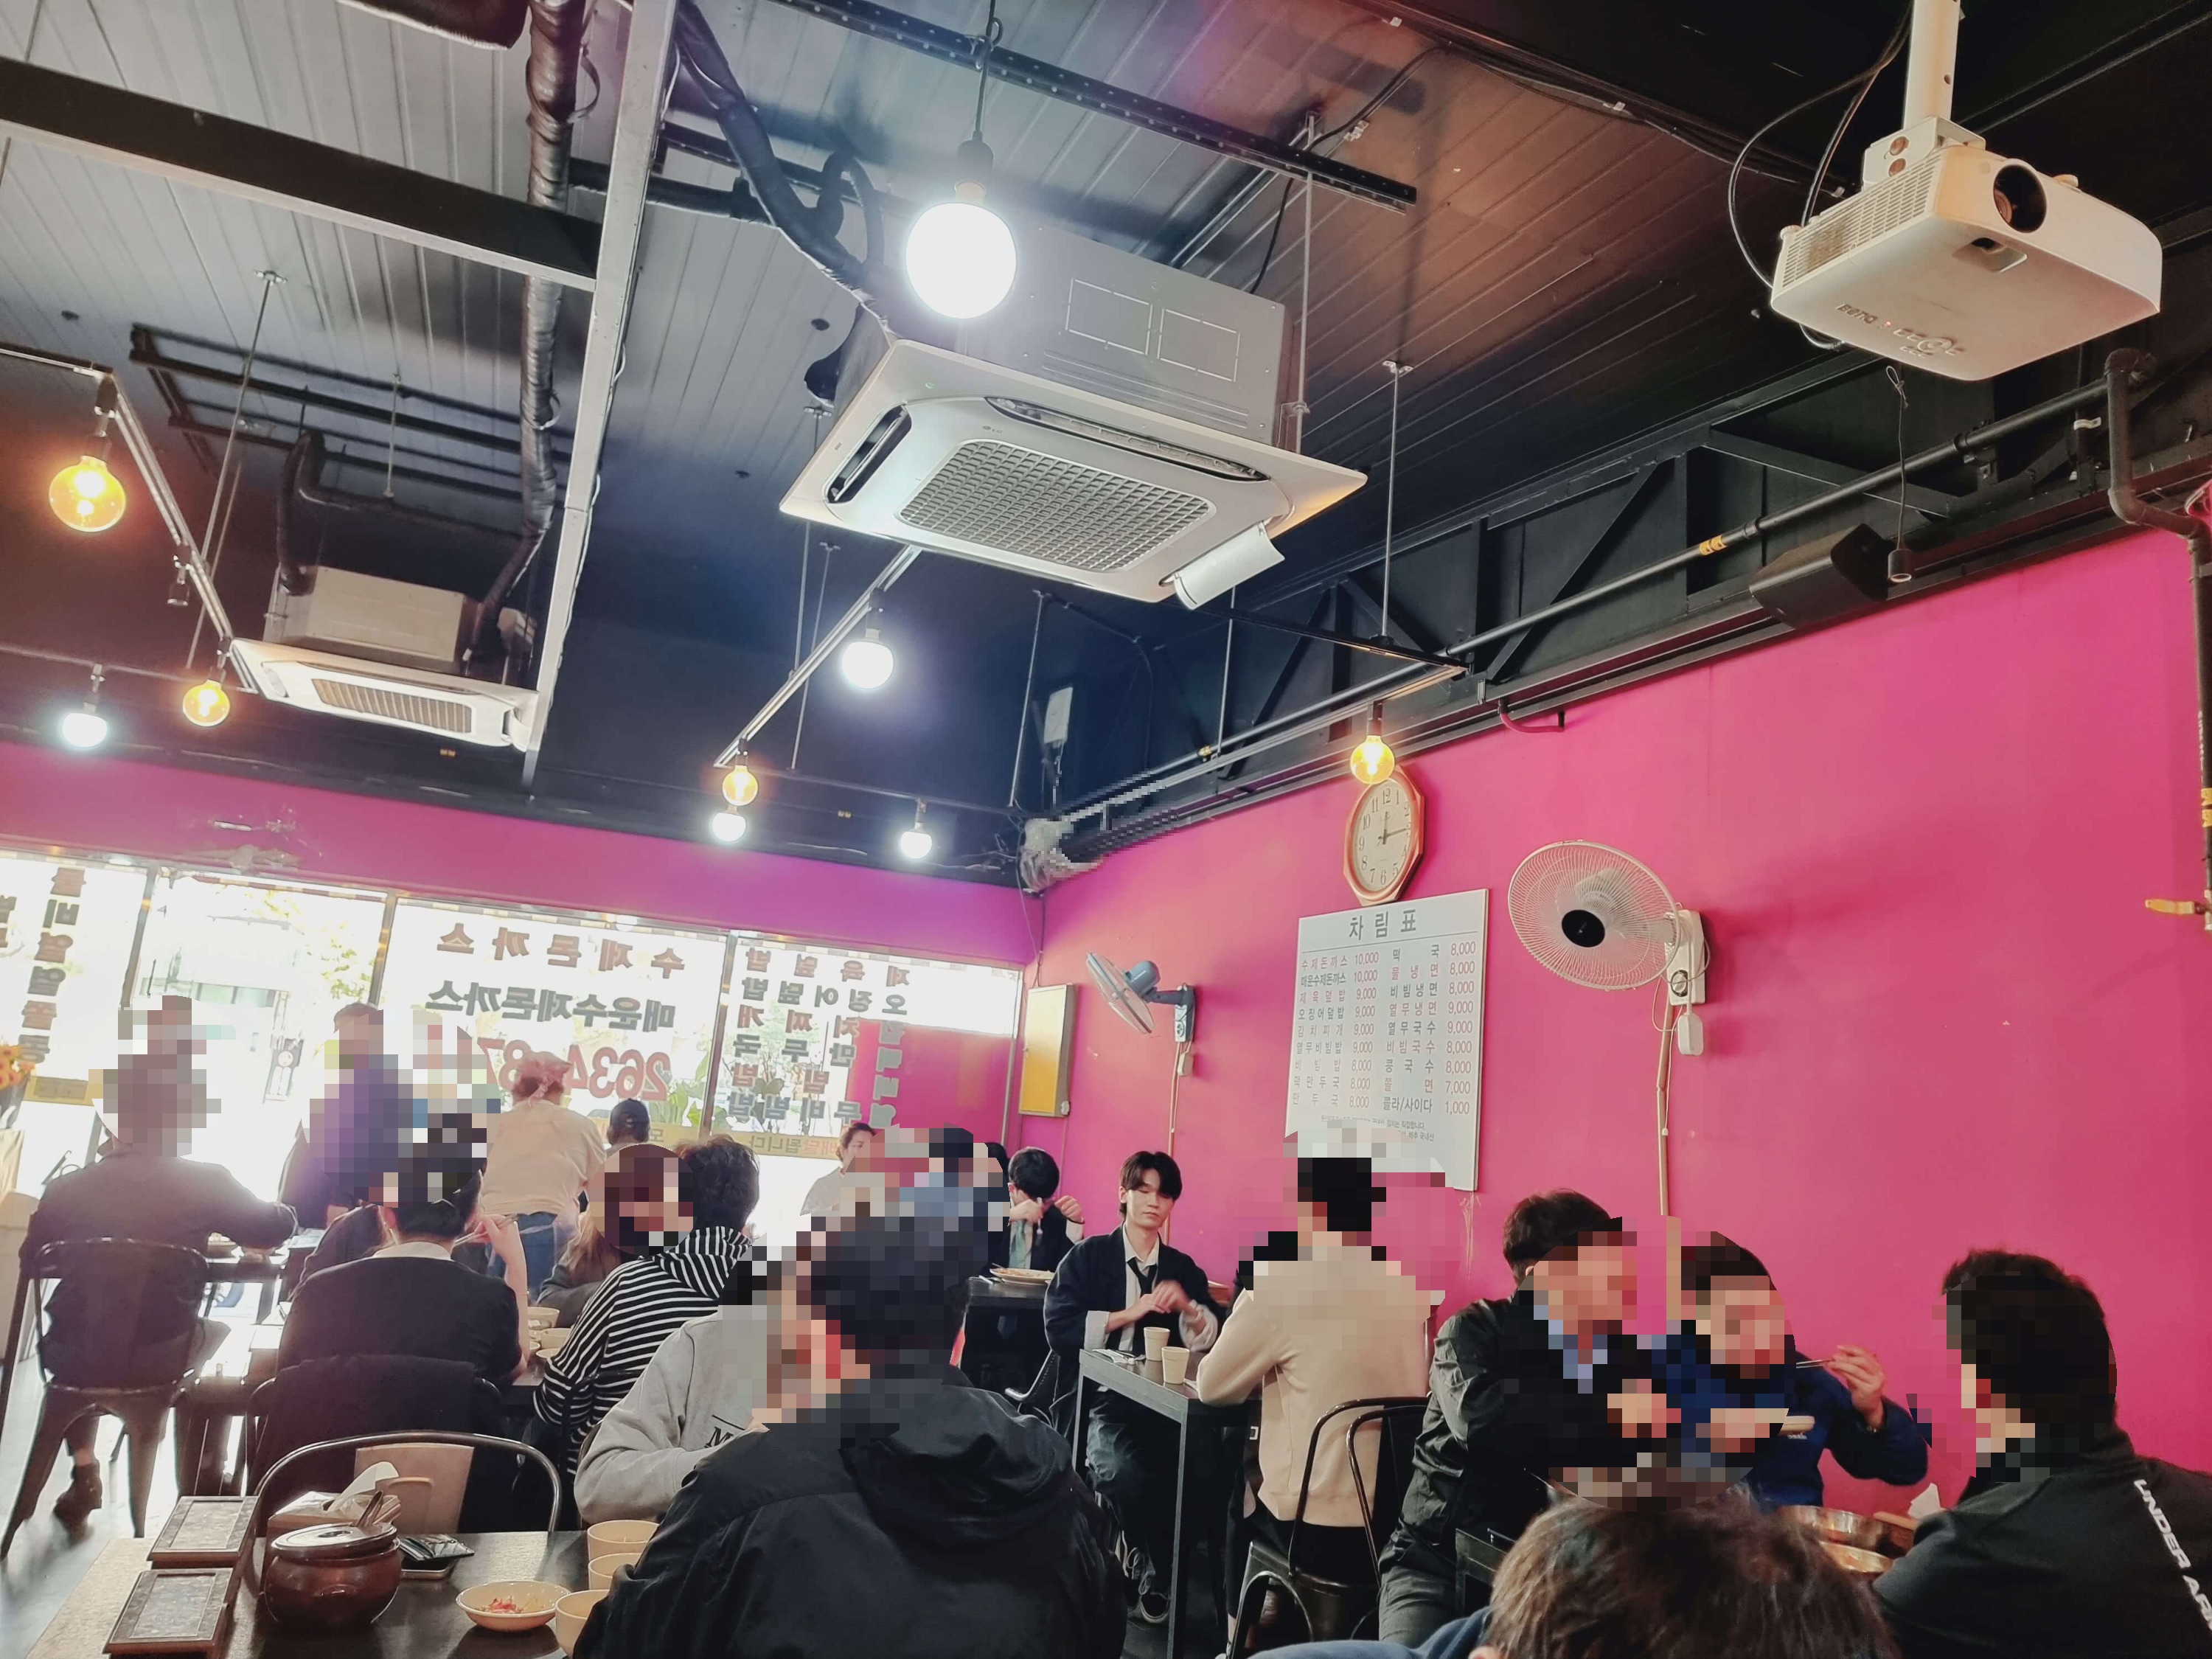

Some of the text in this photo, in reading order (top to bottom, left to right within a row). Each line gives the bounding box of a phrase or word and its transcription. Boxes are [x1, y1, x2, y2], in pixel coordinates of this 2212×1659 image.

[1382, 787, 1391, 804] 12
[1395, 789, 1400, 805] 1
[1371, 797, 1380, 813] 11
[1404, 801, 1411, 817] 2
[1362, 814, 1371, 830] 10
[1358, 836, 1366, 852] 9
[1400, 844, 1408, 858] 4
[1361, 855, 1368, 871] 8
[1392, 862, 1399, 878] 5
[1369, 868, 1376, 883] 7
[1380, 870, 1388, 885] 6
[1450, 942, 1476, 956] 8,000
[1354, 951, 1380, 965] 10,000
[1450, 961, 1475, 976] 8,000
[1354, 970, 1378, 984] 10,000
[1356, 987, 1377, 1001] 9,000
[1448, 981, 1475, 995] 8,000
[1355, 1005, 1376, 1019] 9,000
[1448, 1000, 1474, 1015] 9,000
[1354, 1023, 1374, 1036] 9,000
[1447, 1020, 1473, 1034] 9,000
[1352, 1041, 1373, 1054] 9,000
[1447, 1040, 1472, 1055] 8,000
[1352, 1059, 1371, 1074] 8,000
[1446, 1060, 1472, 1074] 8,000
[1350, 1077, 1371, 1091] 8,000
[1445, 1080, 1471, 1094] 7,000
[1349, 1096, 1369, 1109] 8,000
[1444, 1100, 1470, 1115] 1,000
[2182, 1574, 2212, 1630] AR
